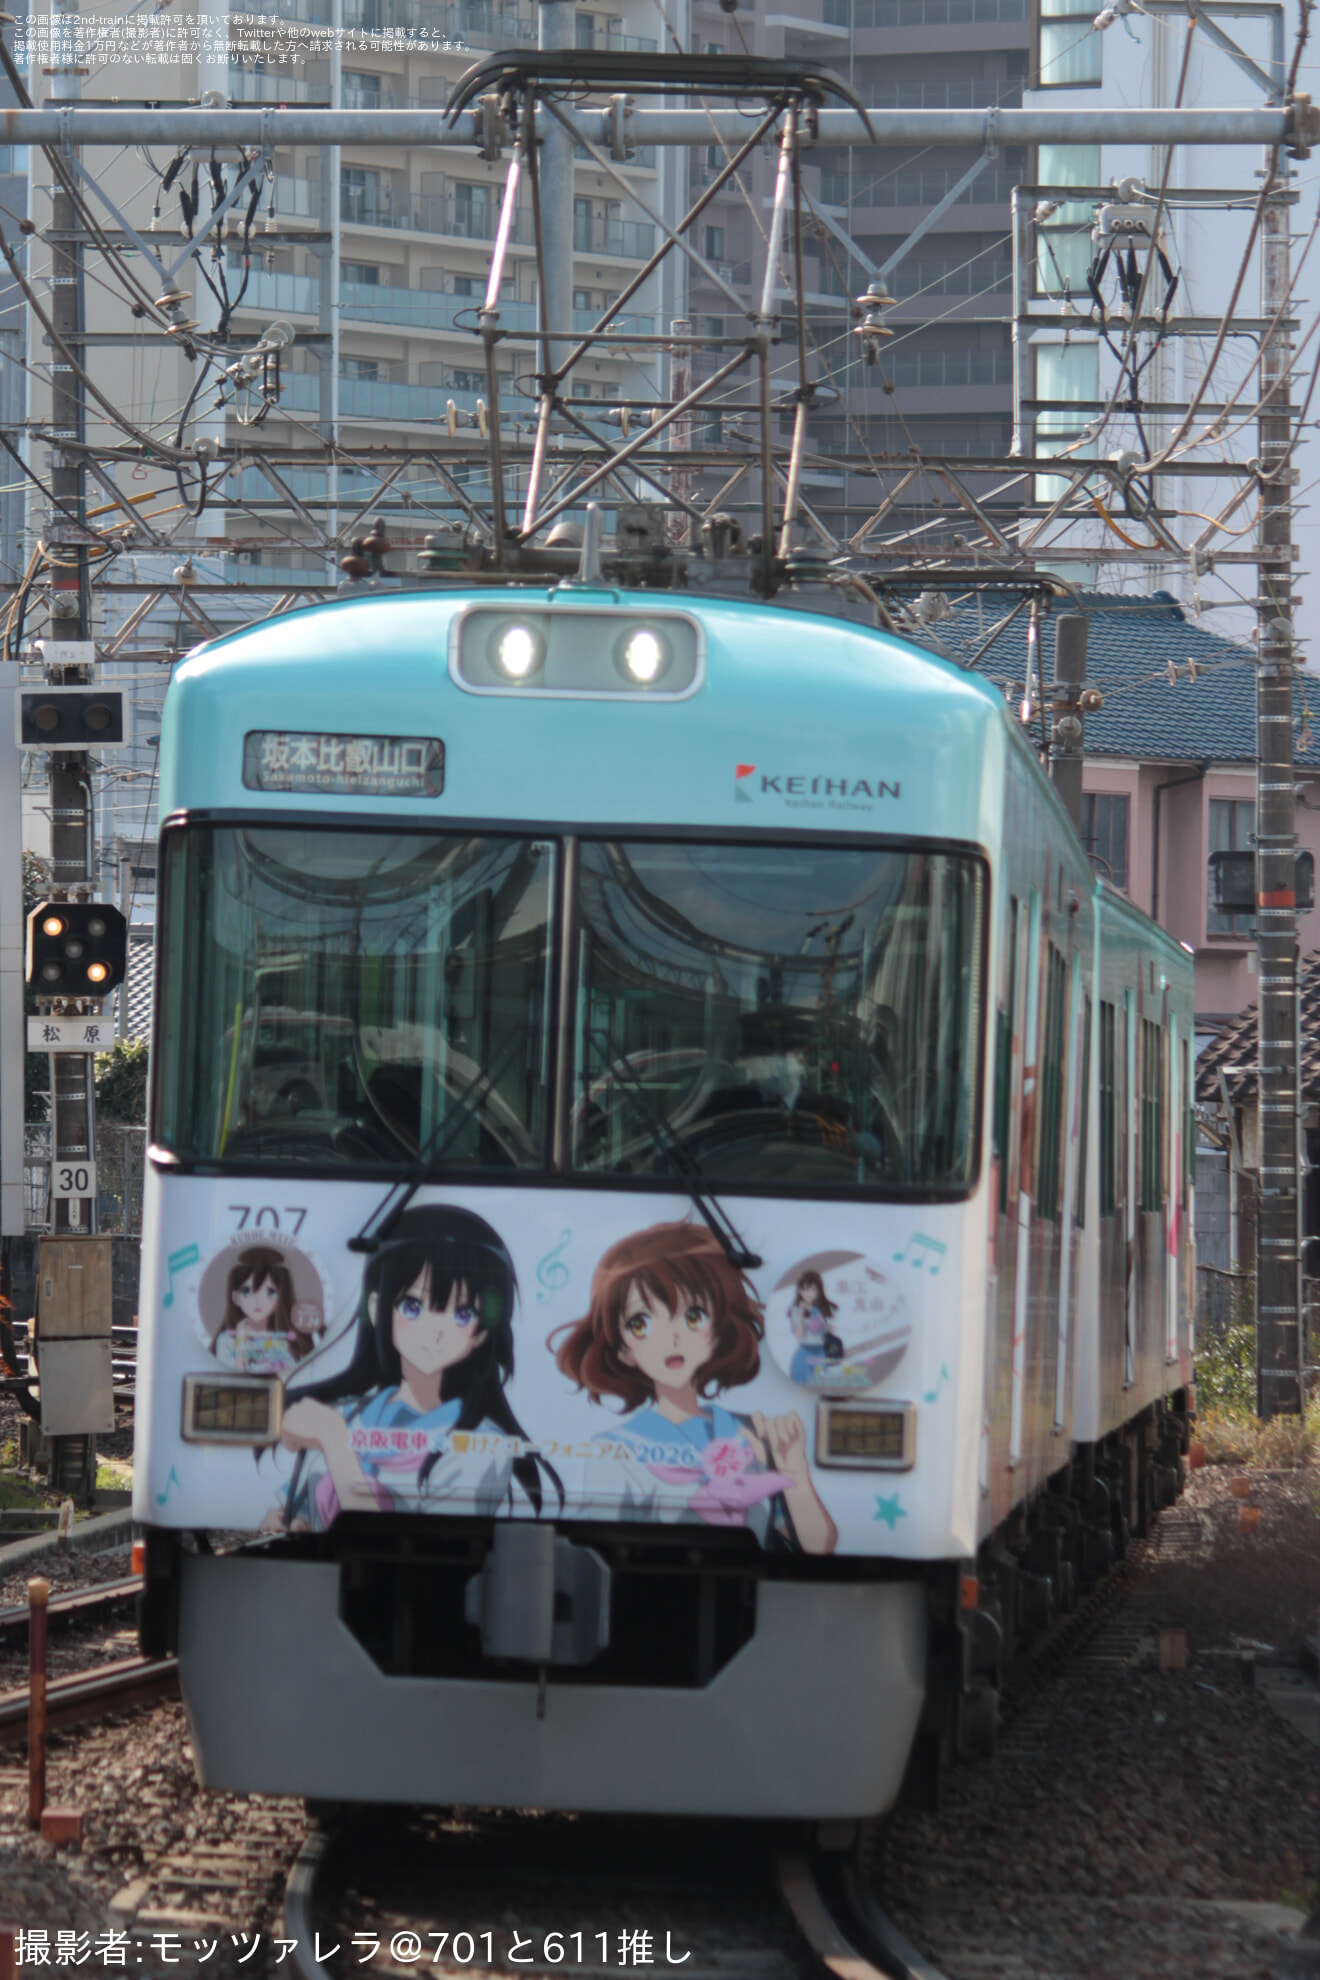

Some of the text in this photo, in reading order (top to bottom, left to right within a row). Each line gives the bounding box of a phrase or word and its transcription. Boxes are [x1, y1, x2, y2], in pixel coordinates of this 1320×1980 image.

[262, 735, 427, 775] 坂本比叡山口
[761, 775, 901, 799] KEIHAN
[42, 1024, 101, 1044] 松原
[59, 1168, 89, 1191] 30
[228, 1205, 307, 1236] 707
[351, 1428, 429, 1451] 京阪電車
[636, 1443, 696, 1465] 2026
